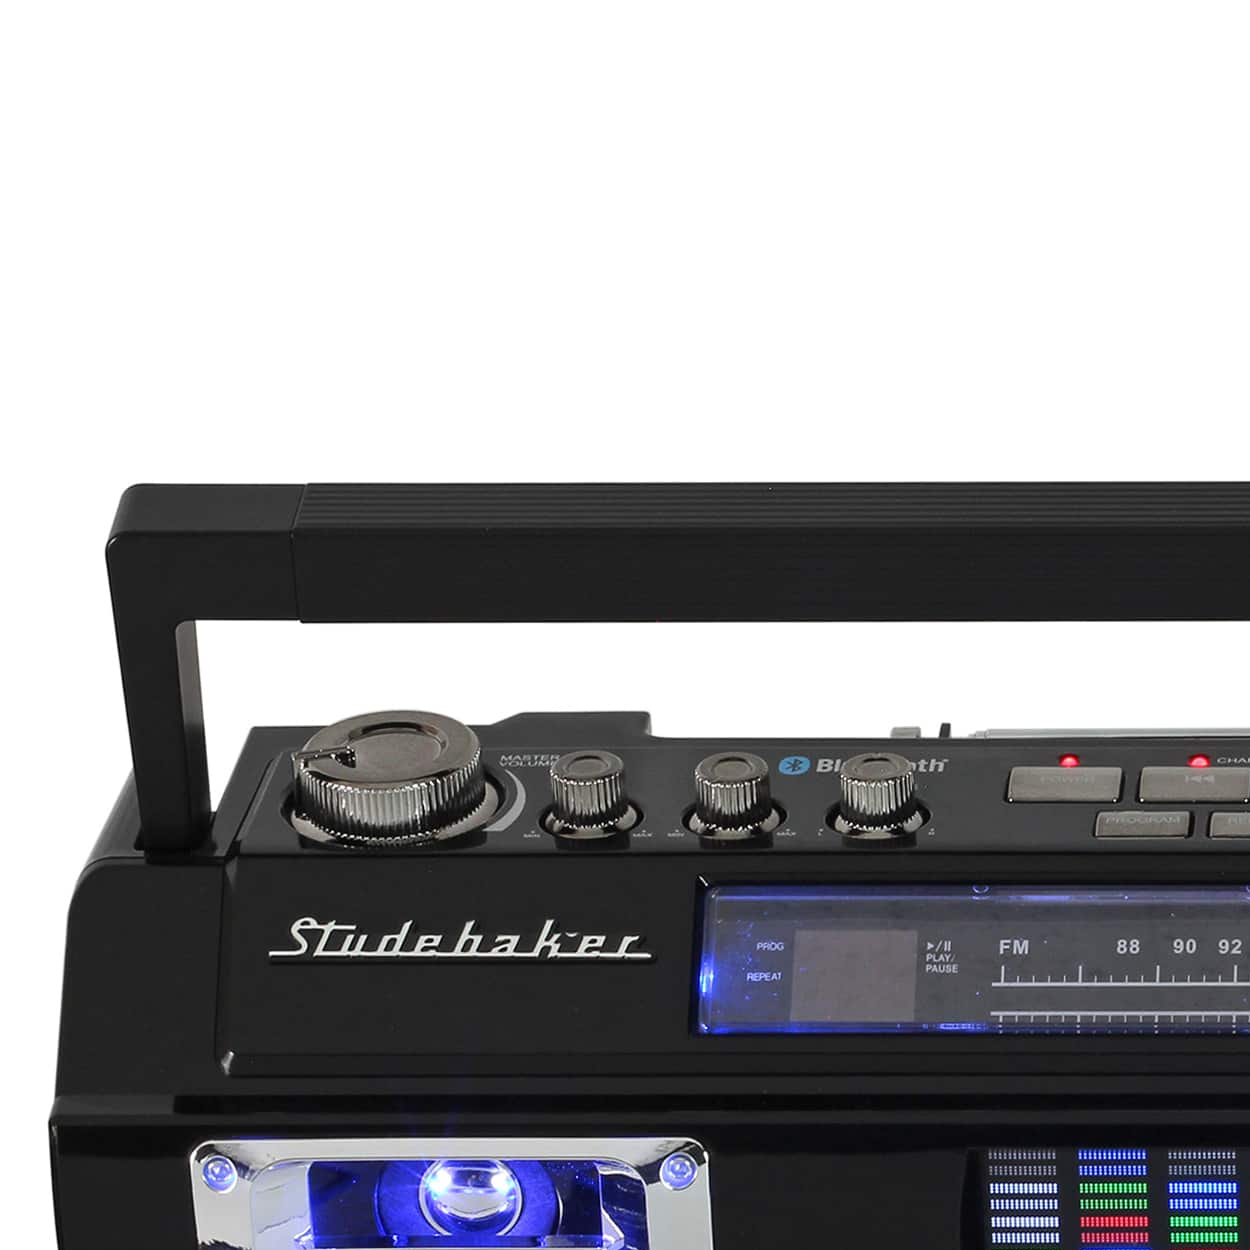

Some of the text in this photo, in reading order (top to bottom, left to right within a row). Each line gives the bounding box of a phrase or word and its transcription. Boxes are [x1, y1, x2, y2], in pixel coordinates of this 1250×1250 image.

[269, 917, 653, 960] Studebaker
[756, 942, 784, 951] PROG
[1000, 939, 1030, 955] FM
[1116, 939, 1140, 954] 88
[1173, 939, 1197, 954] 90
[1218, 939, 1242, 954] 92
[925, 964, 959, 974] PAUSE
[746, 972, 782, 981] REPEAT
